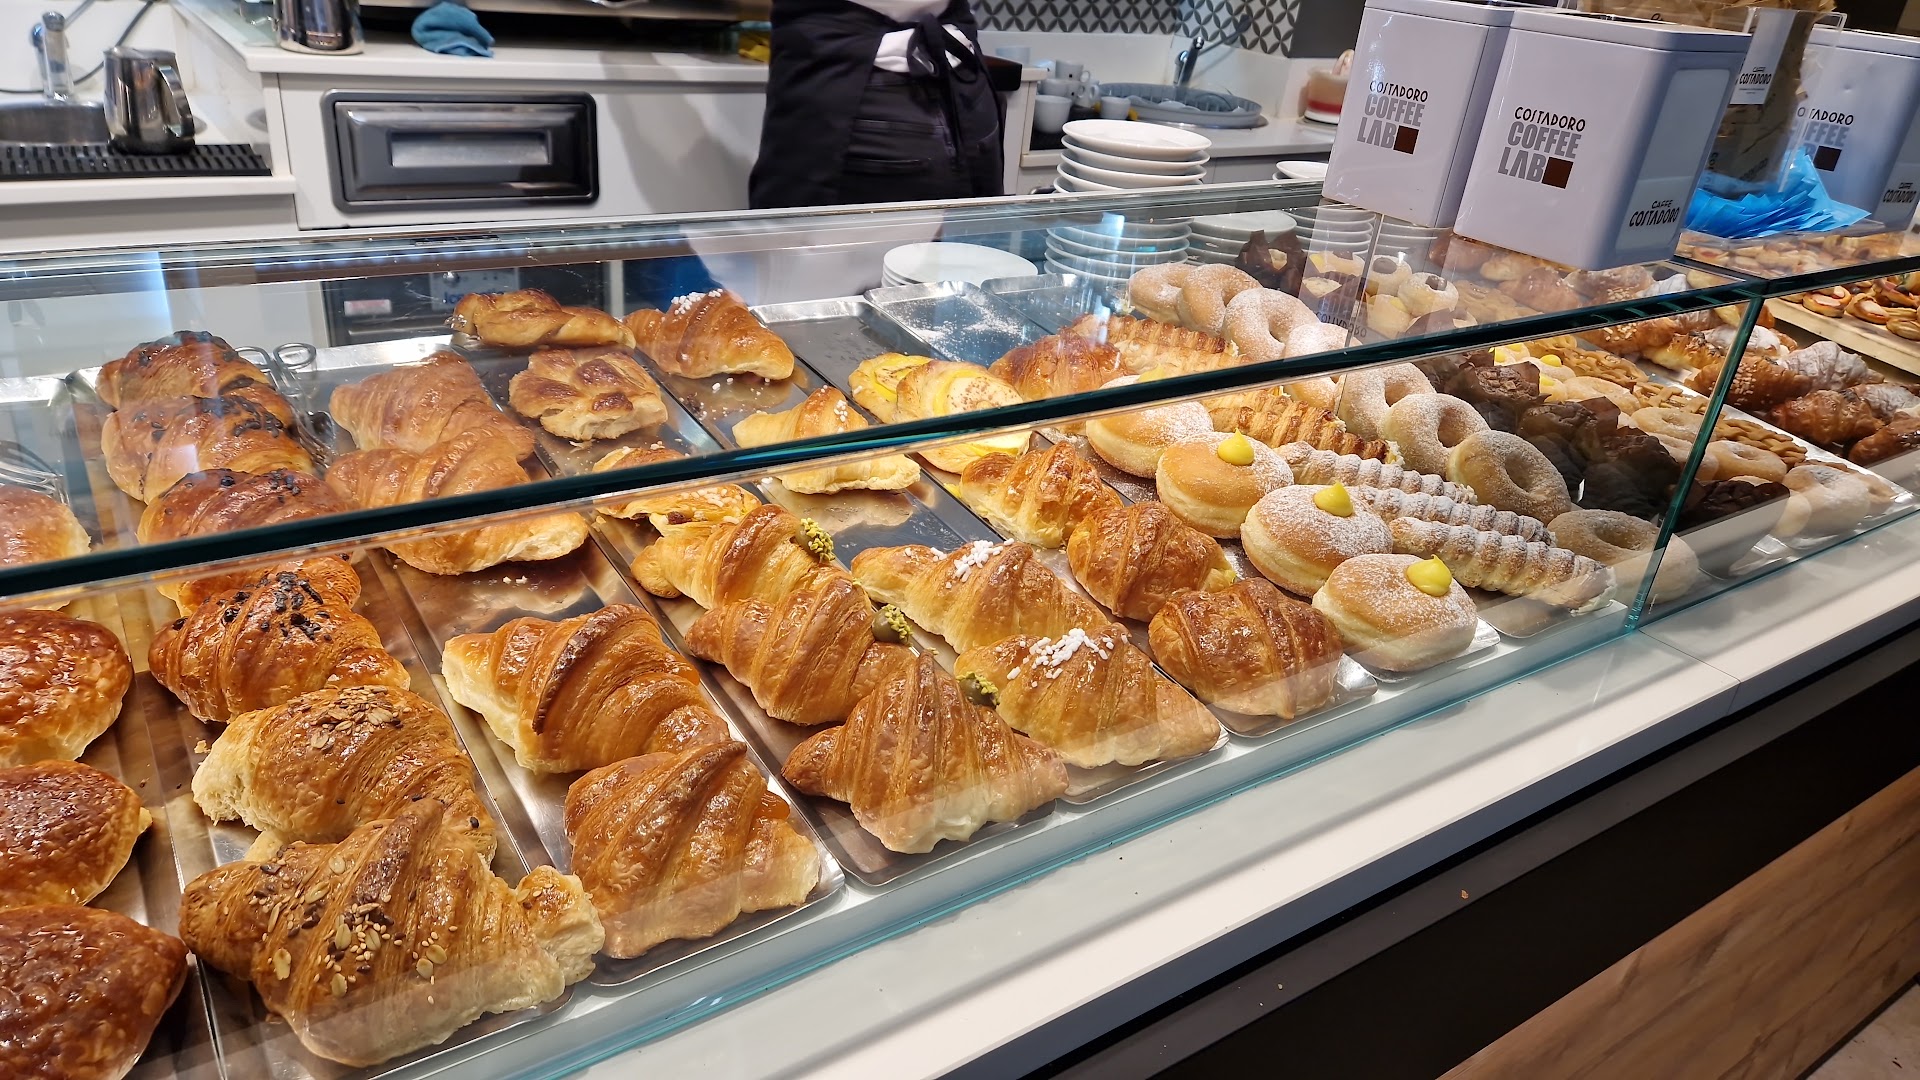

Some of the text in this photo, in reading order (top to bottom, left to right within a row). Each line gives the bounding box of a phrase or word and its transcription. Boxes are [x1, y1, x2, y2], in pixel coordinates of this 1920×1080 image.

[1369, 81, 1428, 102] COSTADORO
[1364, 94, 1426, 127] COFFEE
[1514, 106, 1586, 132] COSTADORO
[1796, 106, 1854, 126] OTADORO
[1357, 116, 1397, 148] LAB
[1507, 121, 1582, 159] COFFEE
[1797, 119, 1850, 147] FFEE
[1498, 146, 1547, 182] LAB
[1629, 206, 1680, 227] COSTADORO
